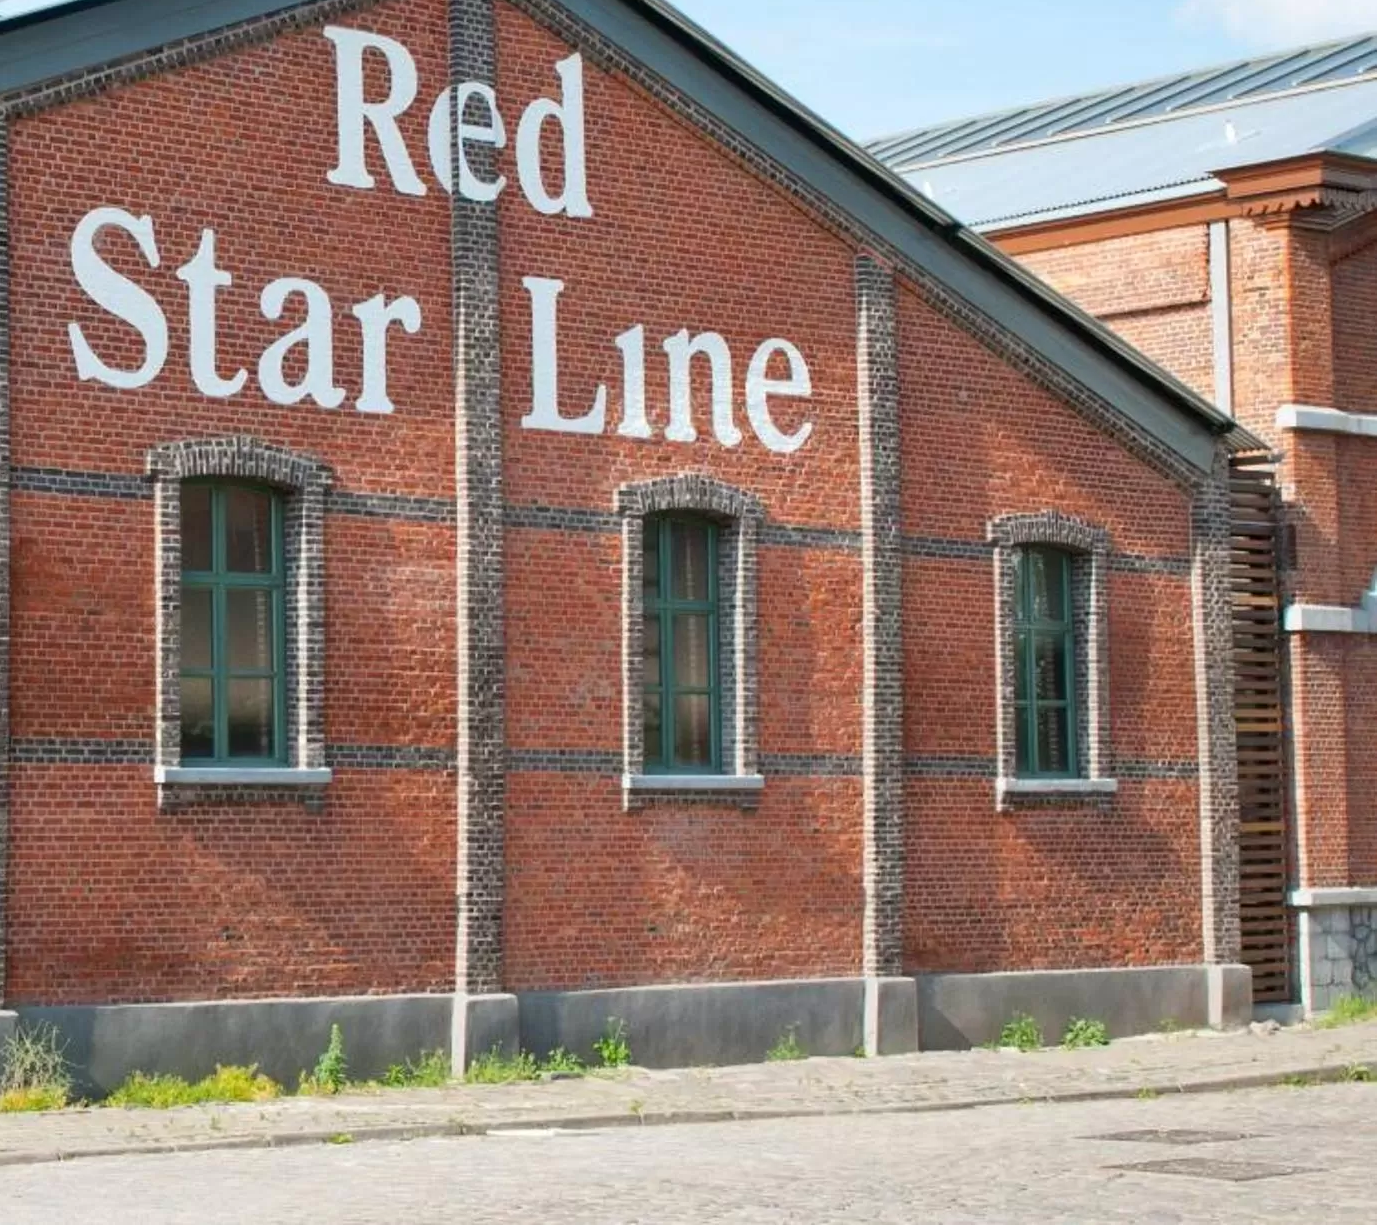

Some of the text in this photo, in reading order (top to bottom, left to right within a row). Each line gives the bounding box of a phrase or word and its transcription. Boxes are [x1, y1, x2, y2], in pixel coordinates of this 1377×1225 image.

[323, 25, 593, 218] Red
[68, 206, 813, 454] Star Line
